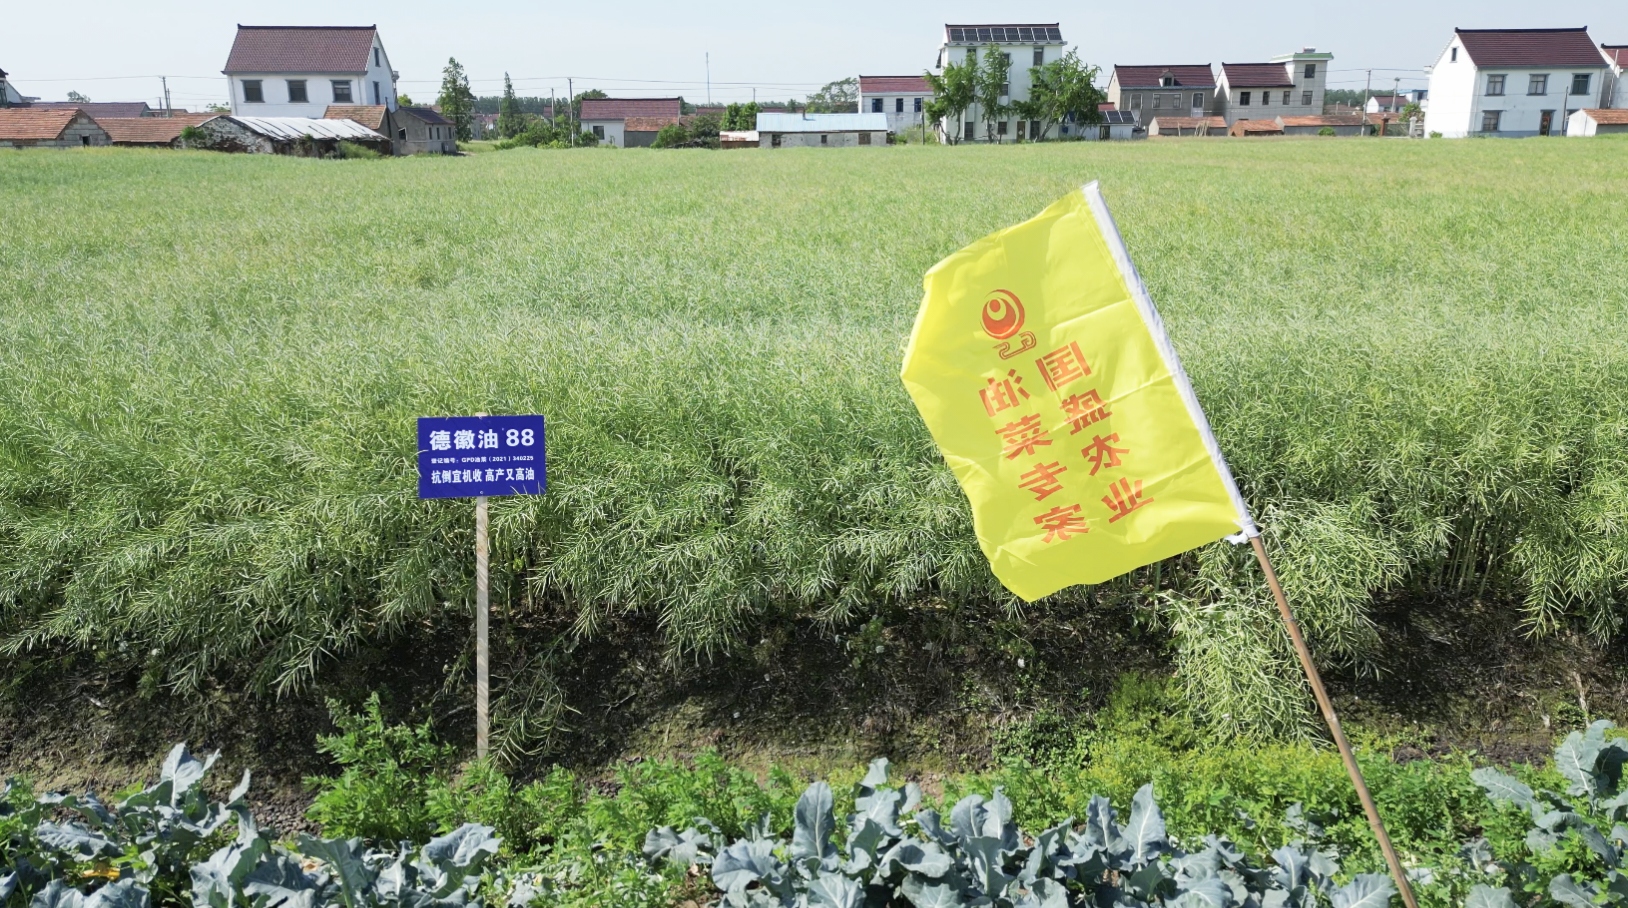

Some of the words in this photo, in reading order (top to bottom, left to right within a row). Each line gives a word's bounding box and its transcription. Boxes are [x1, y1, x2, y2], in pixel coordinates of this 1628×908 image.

[429, 429, 499, 451] 德徽油
[506, 428, 535, 447] 88
[431, 468, 483, 484] 抗倒宜机收
[485, 467, 535, 482] 高产又高油
